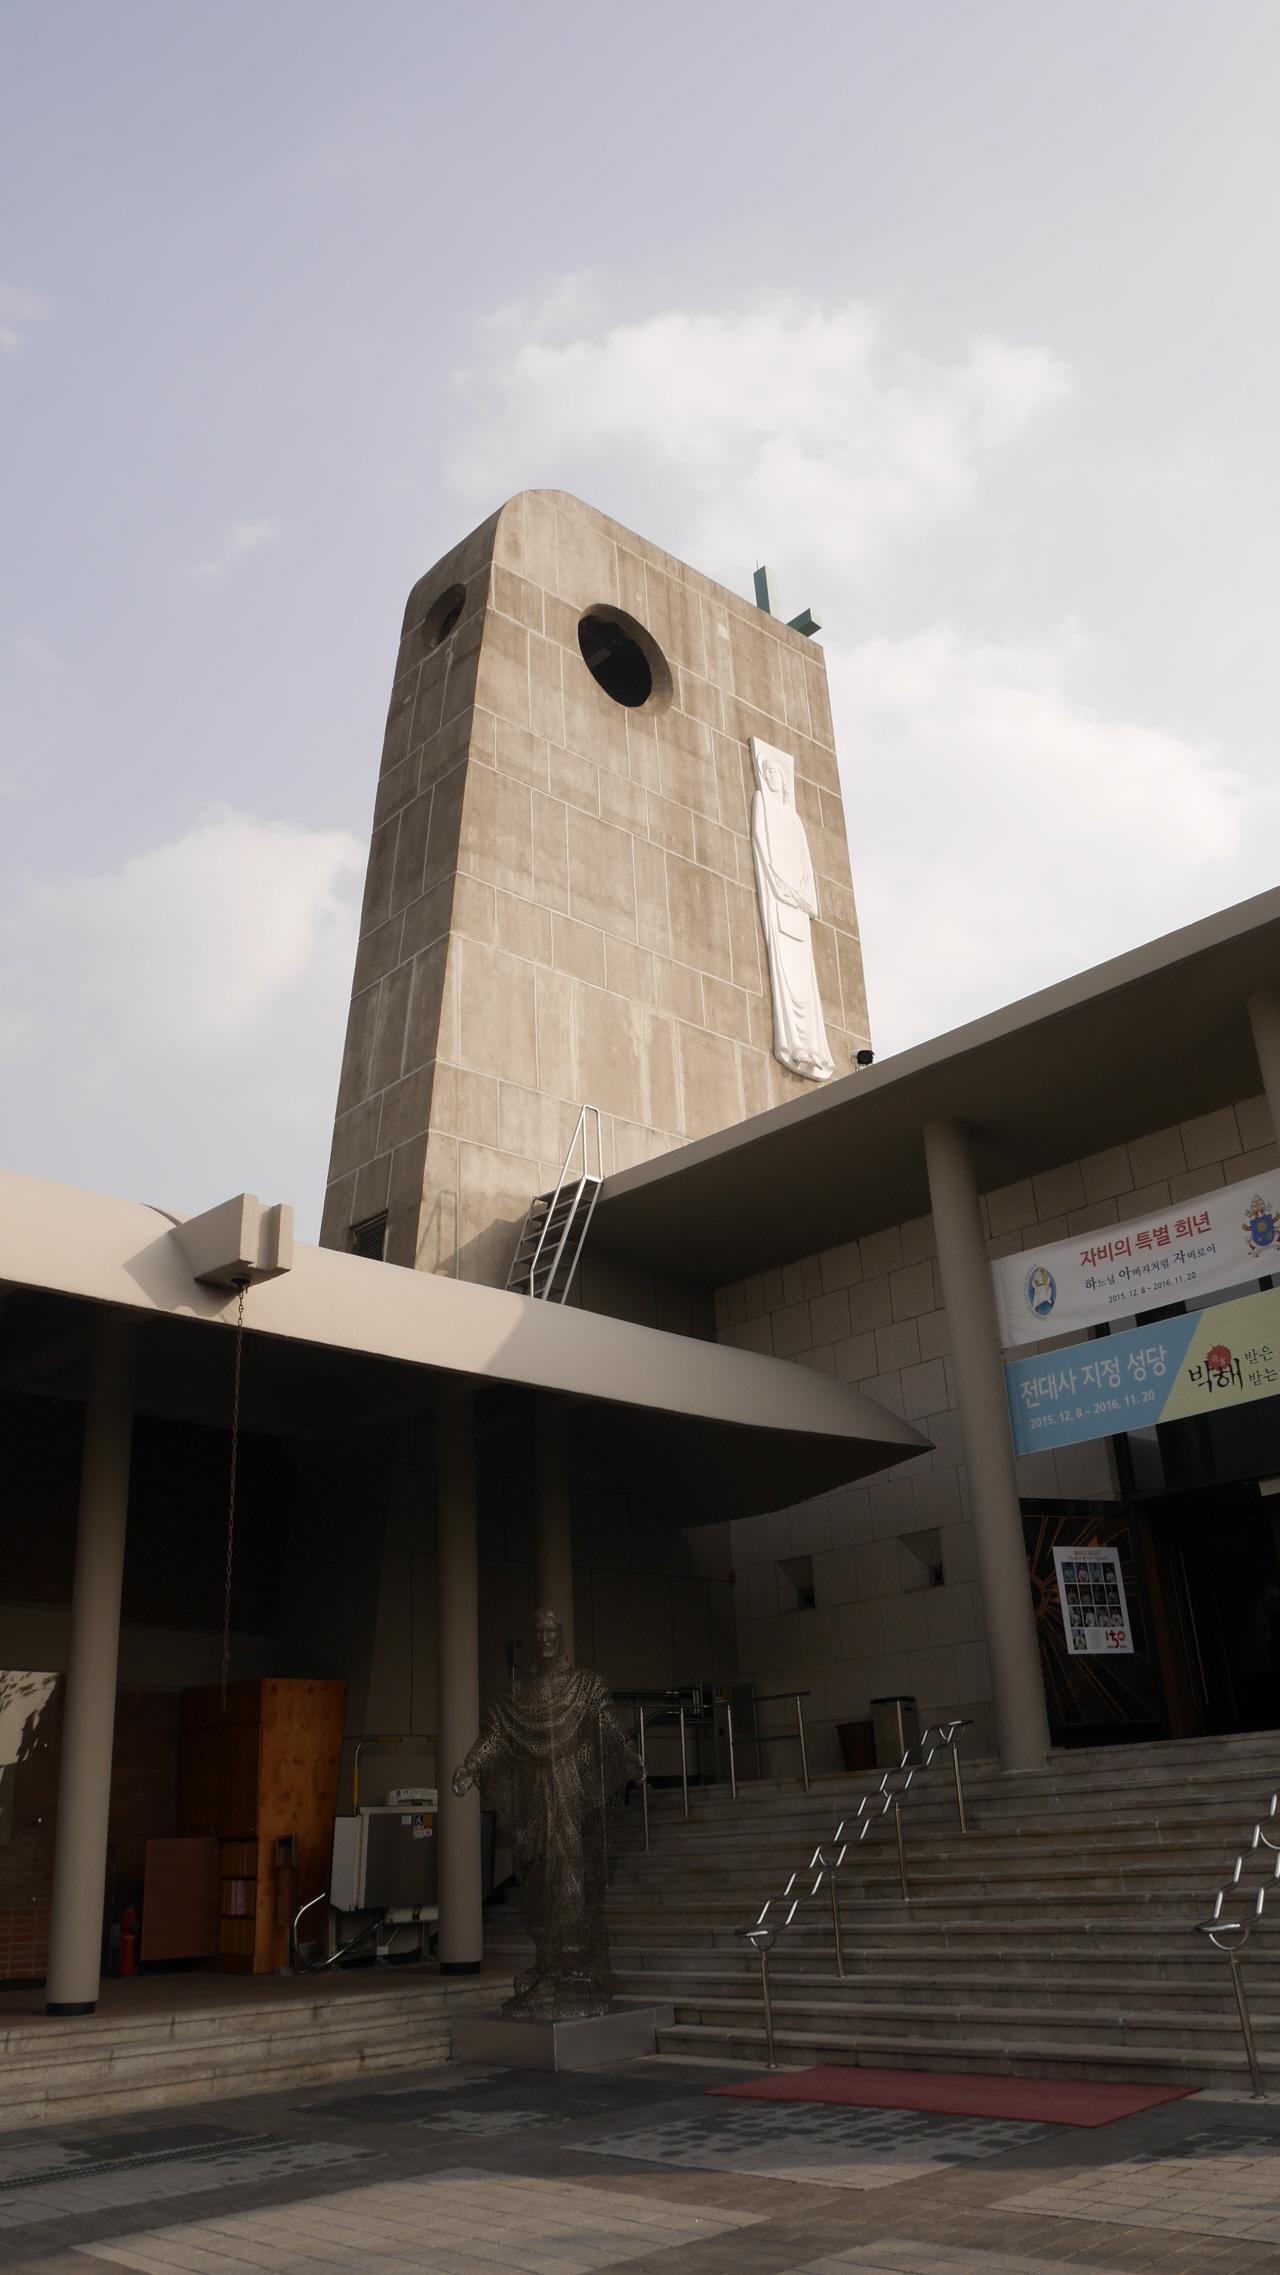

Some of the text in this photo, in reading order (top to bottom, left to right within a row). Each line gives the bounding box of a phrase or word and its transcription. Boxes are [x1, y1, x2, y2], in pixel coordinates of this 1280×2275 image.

[1080, 1211, 1211, 1267] 자비의 특별 희년
[1084, 1243, 1216, 1290] 하느님 아버지처럼 자비로이
[1109, 1292, 1126, 1303] 2015.
[1153, 1278, 1173, 1291] 2016.
[1187, 1271, 1197, 1281] 20
[1244, 1345, 1273, 1365] 받은
[1019, 1344, 1168, 1409] 전대사 지정 성당
[1188, 1358, 1243, 1393] 박해
[1248, 1368, 1278, 1386] 받는
[1030, 1414, 1057, 1430] 2015.
[1094, 1398, 1121, 1414] 2016.
[1142, 1389, 1156, 1402] 20
